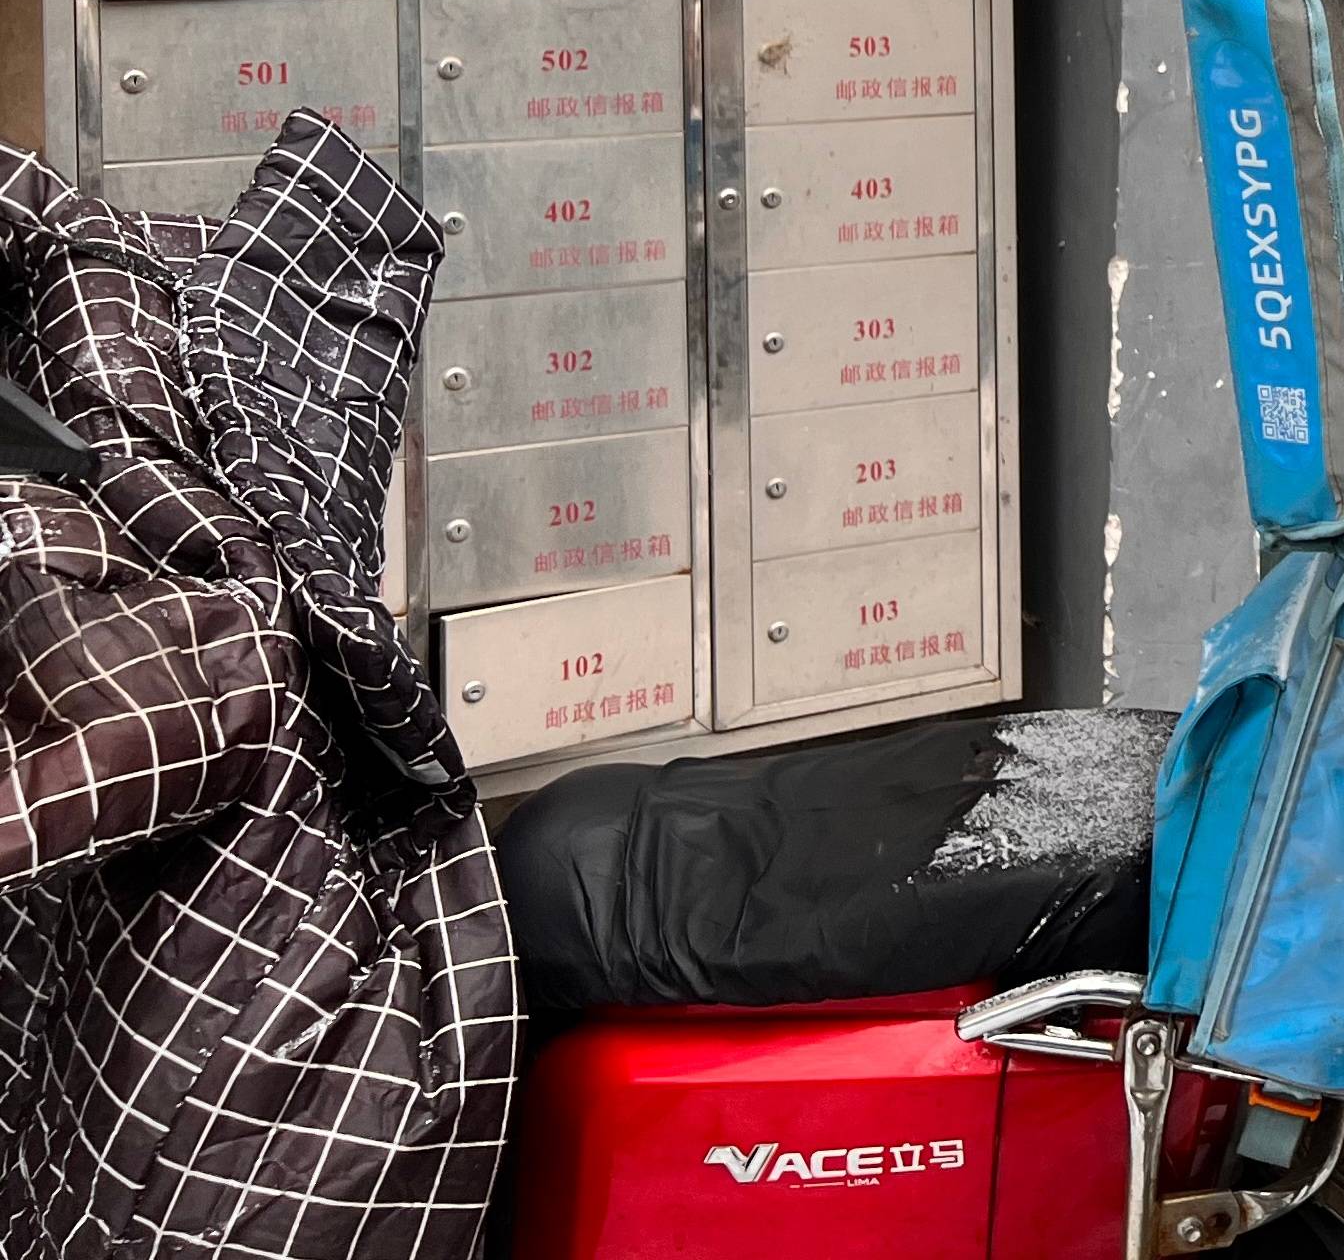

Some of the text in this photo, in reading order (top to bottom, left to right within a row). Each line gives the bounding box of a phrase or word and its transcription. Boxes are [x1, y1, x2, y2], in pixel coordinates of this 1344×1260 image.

[850, 36, 893, 58] 503
[239, 62, 291, 88] 501
[543, 50, 590, 73] 502
[836, 77, 958, 102] 邮政信报箱
[527, 92, 665, 119] 邮政信报箱
[223, 107, 377, 134] 邮政报箱
[851, 178, 895, 200] 403
[543, 200, 594, 225] 402
[838, 216, 961, 243] 邮政信报箱
[1230, 108, 1293, 351] 5QEXSYPG
[531, 241, 667, 270] 邮政信报箱
[856, 319, 897, 339] 303
[547, 351, 595, 374] 302
[841, 356, 963, 386] 邮政信报箱
[531, 388, 671, 423] 邮政信报箱
[856, 459, 899, 486] 203
[552, 500, 597, 529] 202
[843, 494, 966, 528] 邮政信报箱
[534, 536, 674, 575] 邮政信报箱
[859, 600, 901, 627] 103
[844, 632, 967, 671] 邮政信报箱
[562, 653, 606, 683] 102
[543, 681, 678, 731] 邮政信报箱
[889, 1139, 965, 1173] 立马
[846, 1177, 881, 1188] LIMA
